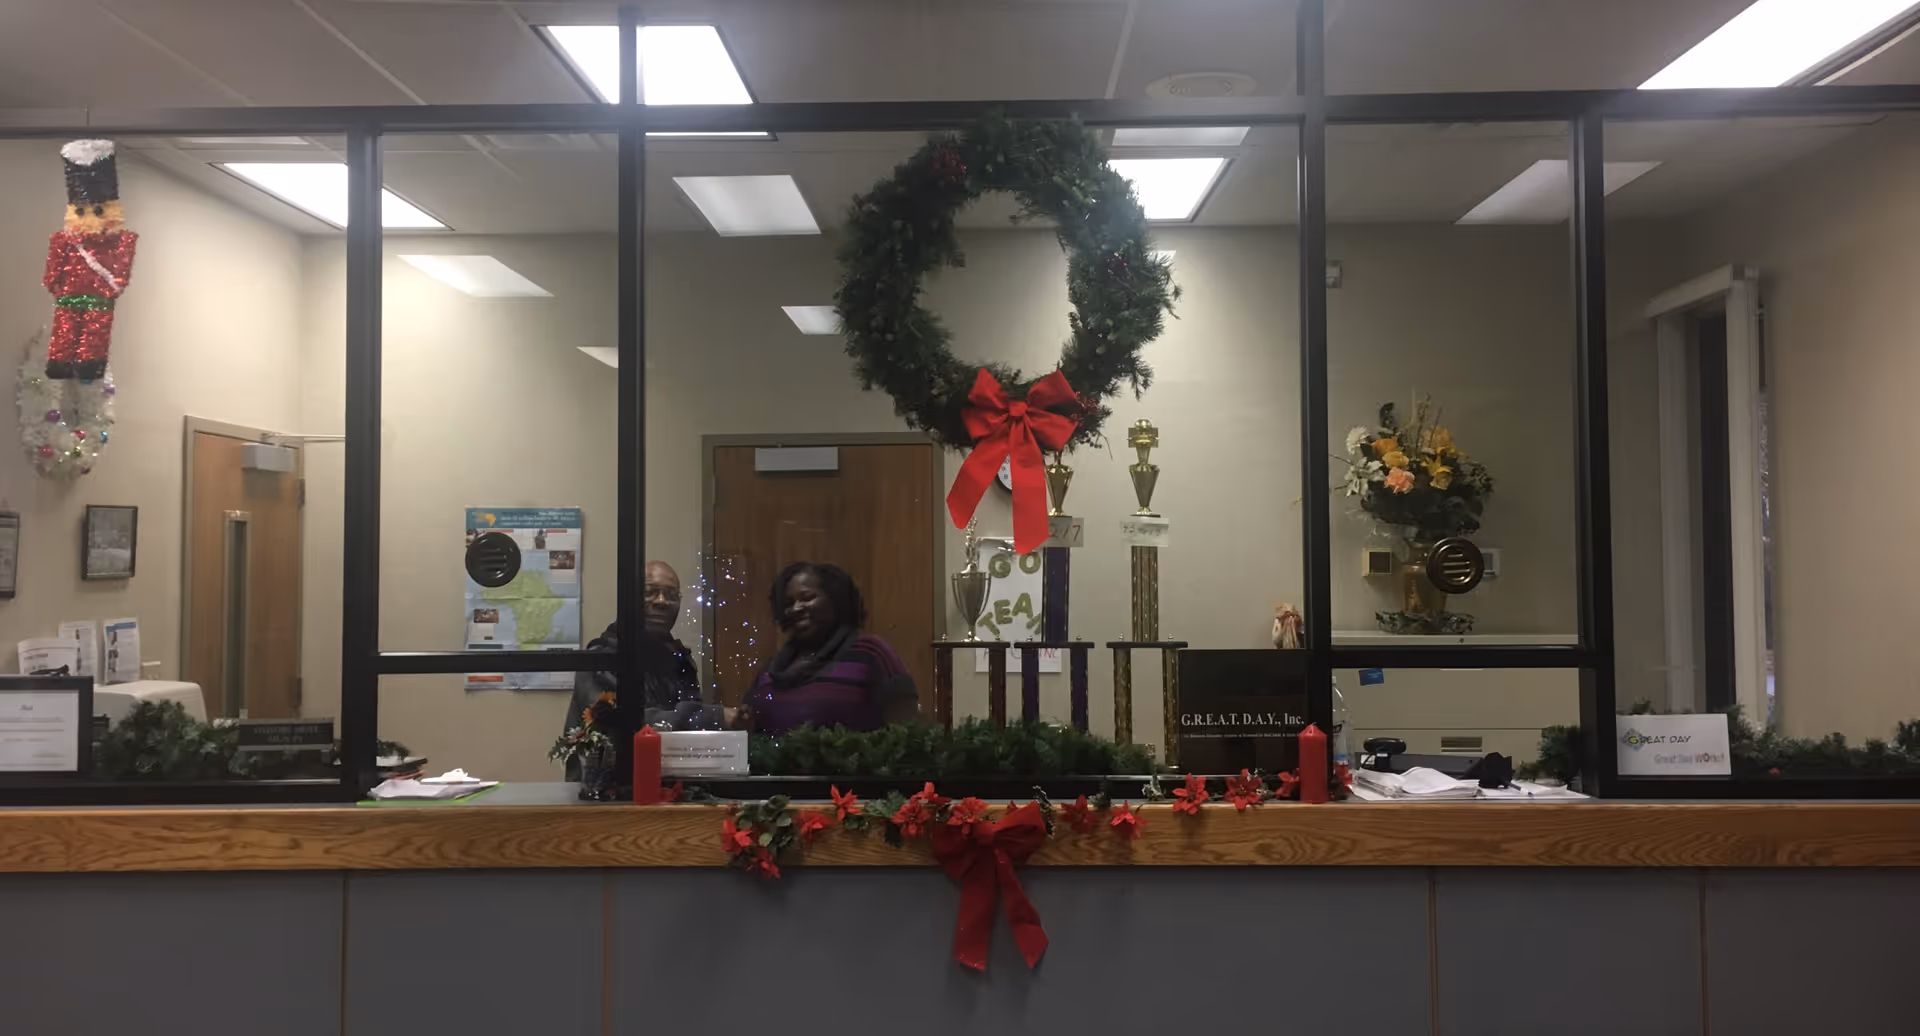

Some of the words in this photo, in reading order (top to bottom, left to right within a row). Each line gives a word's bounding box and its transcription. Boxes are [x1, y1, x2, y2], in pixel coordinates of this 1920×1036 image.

[988, 551, 1041, 578] GO
[1181, 713, 1240, 726] G.R.E.A.T.
[1284, 713, 1305, 725] Inc.
[1669, 735, 1691, 744] DAY
